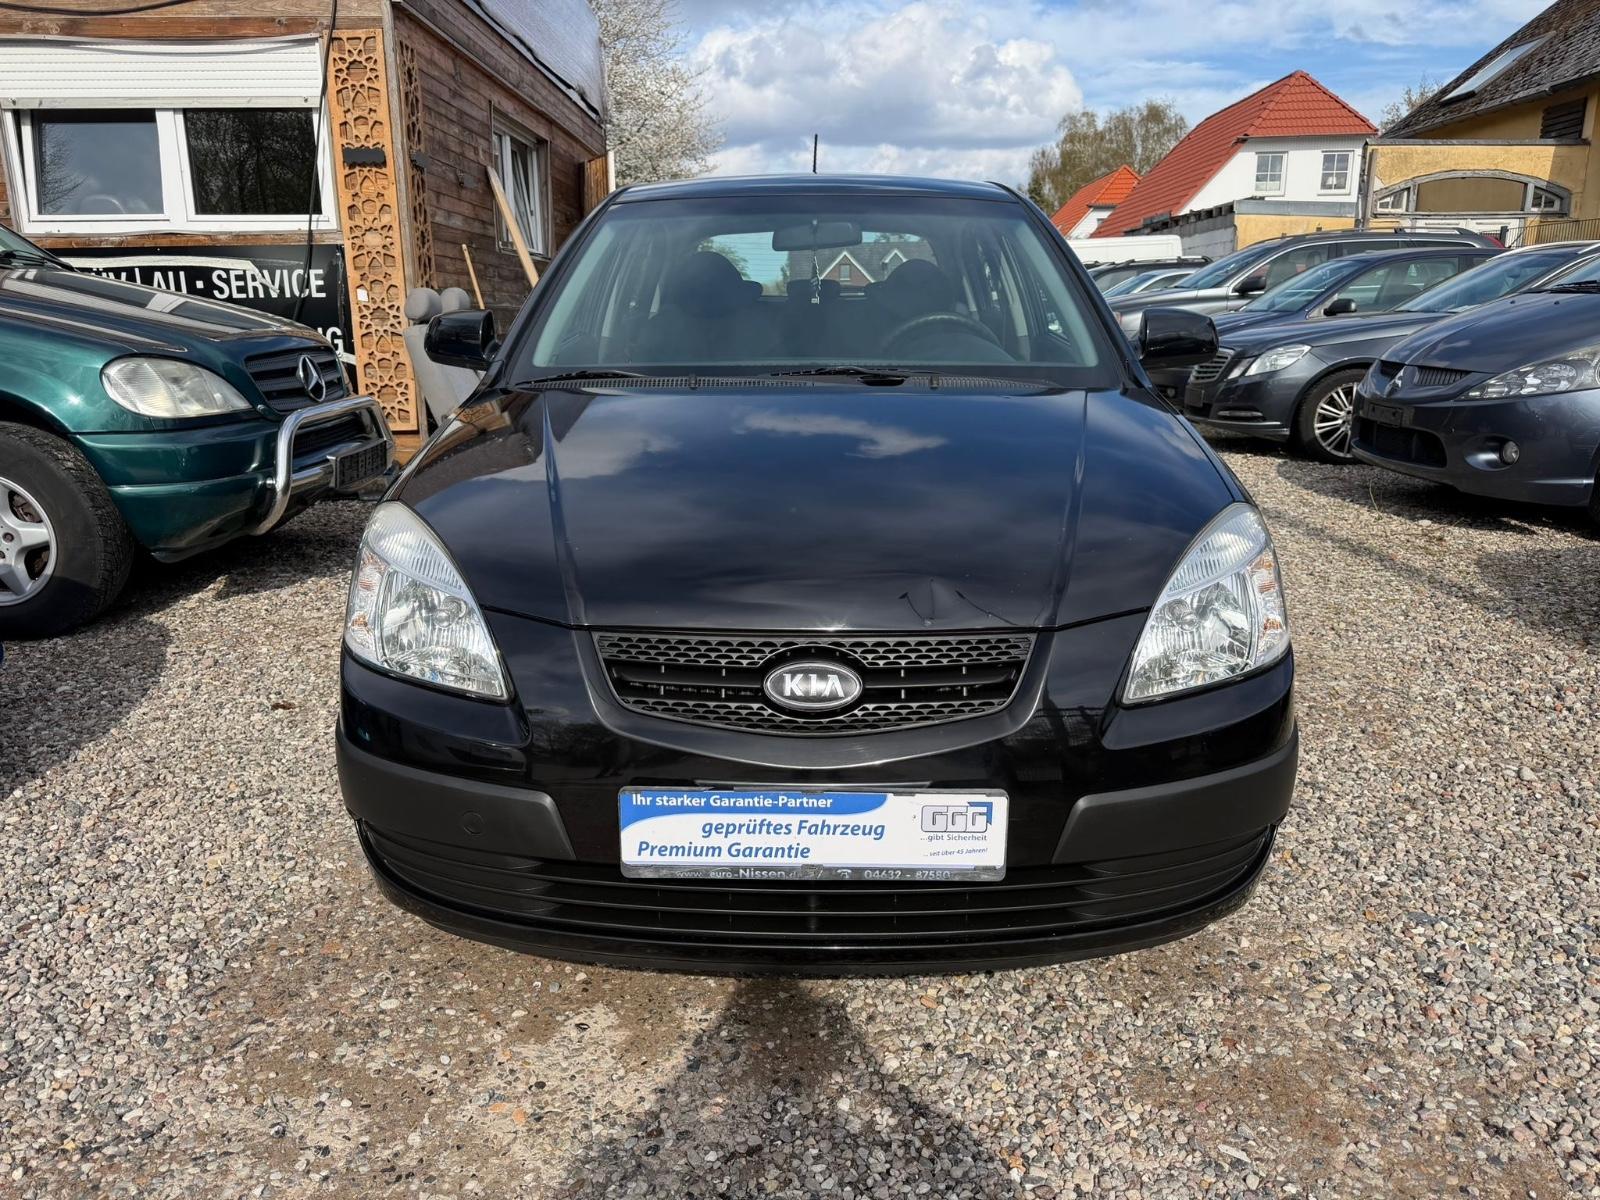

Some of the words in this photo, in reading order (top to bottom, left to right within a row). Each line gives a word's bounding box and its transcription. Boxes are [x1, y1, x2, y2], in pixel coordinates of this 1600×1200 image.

[212, 269, 326, 299] SERVICE
[783, 673, 845, 697] KIA
[632, 794, 652, 806] Ihr
[655, 795, 706, 807] starker
[710, 795, 833, 808] Garantie-Partner
[701, 819, 792, 838] geprüftes
[797, 819, 885, 841] Fahrzeug
[637, 841, 722, 857] Premium
[727, 842, 811, 859] Garantie
[864, 870, 901, 880] 04632
